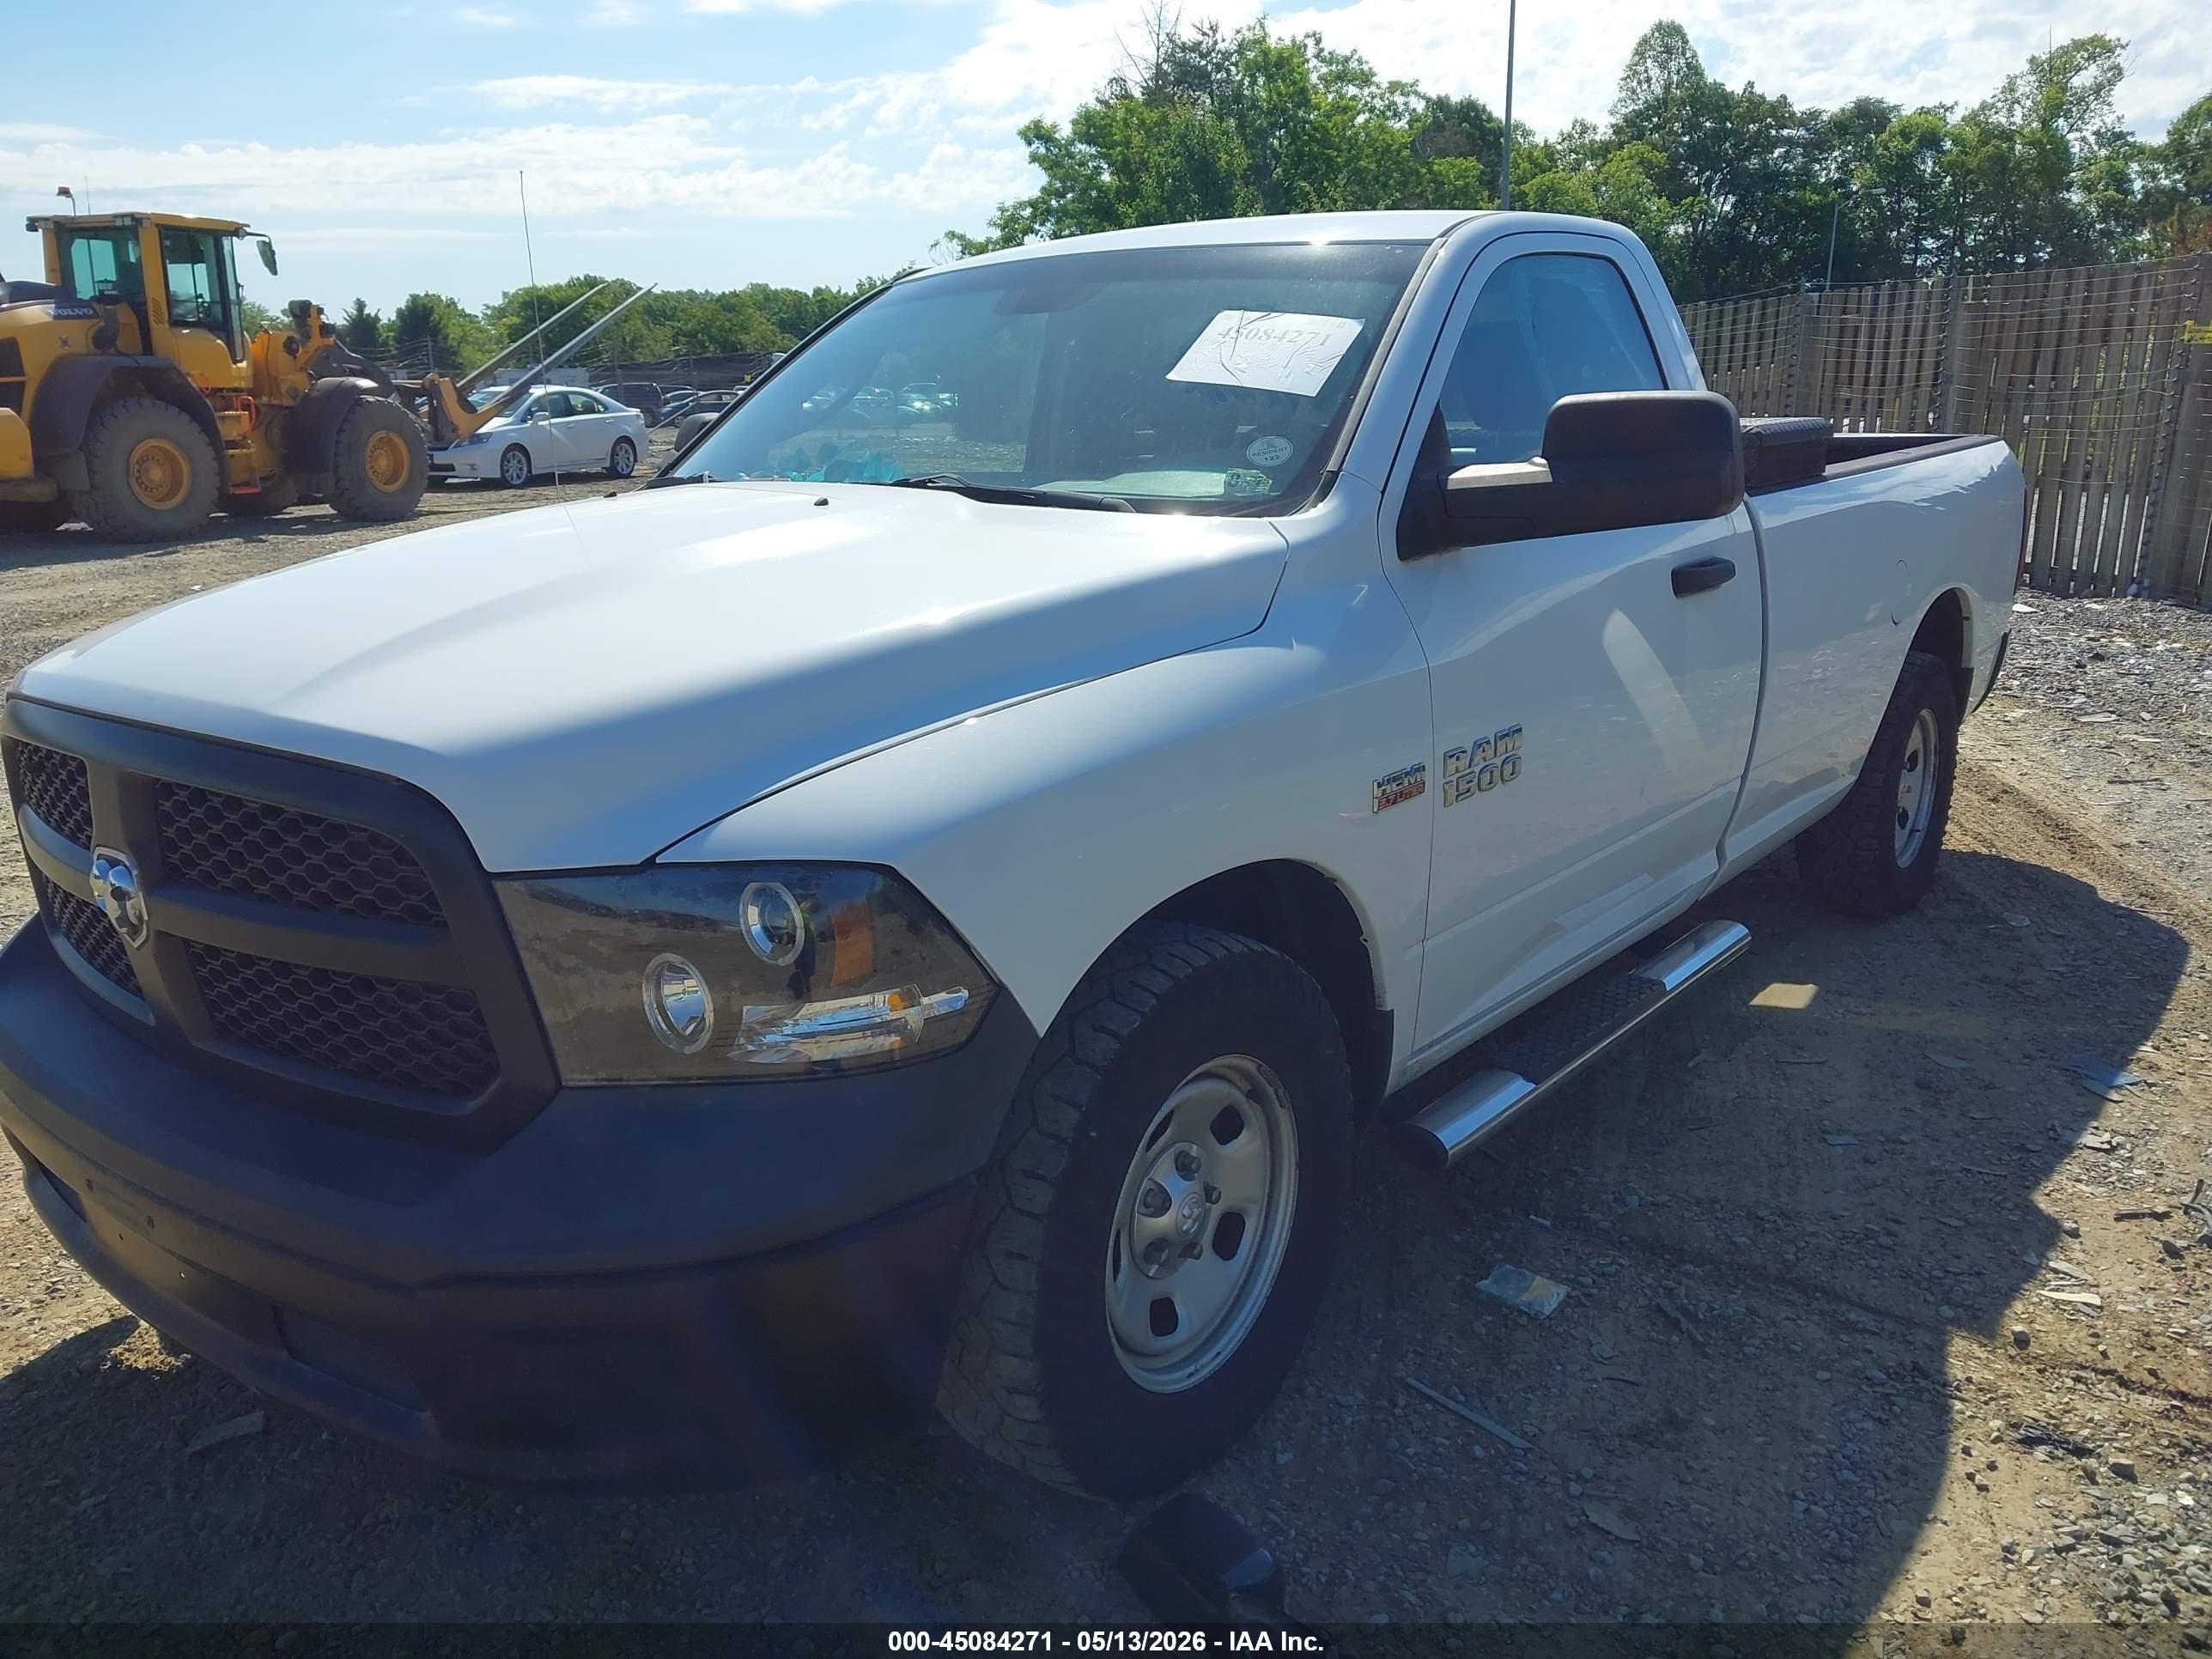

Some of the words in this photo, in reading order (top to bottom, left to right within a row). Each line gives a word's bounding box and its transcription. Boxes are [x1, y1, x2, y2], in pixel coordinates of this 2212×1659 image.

[46, 307, 94, 316] VOLVO
[1217, 325, 1333, 346] 45084271
[1443, 722, 1523, 779] RAM
[1373, 763, 1426, 799] HEMI
[1443, 753, 1523, 808] 1500
